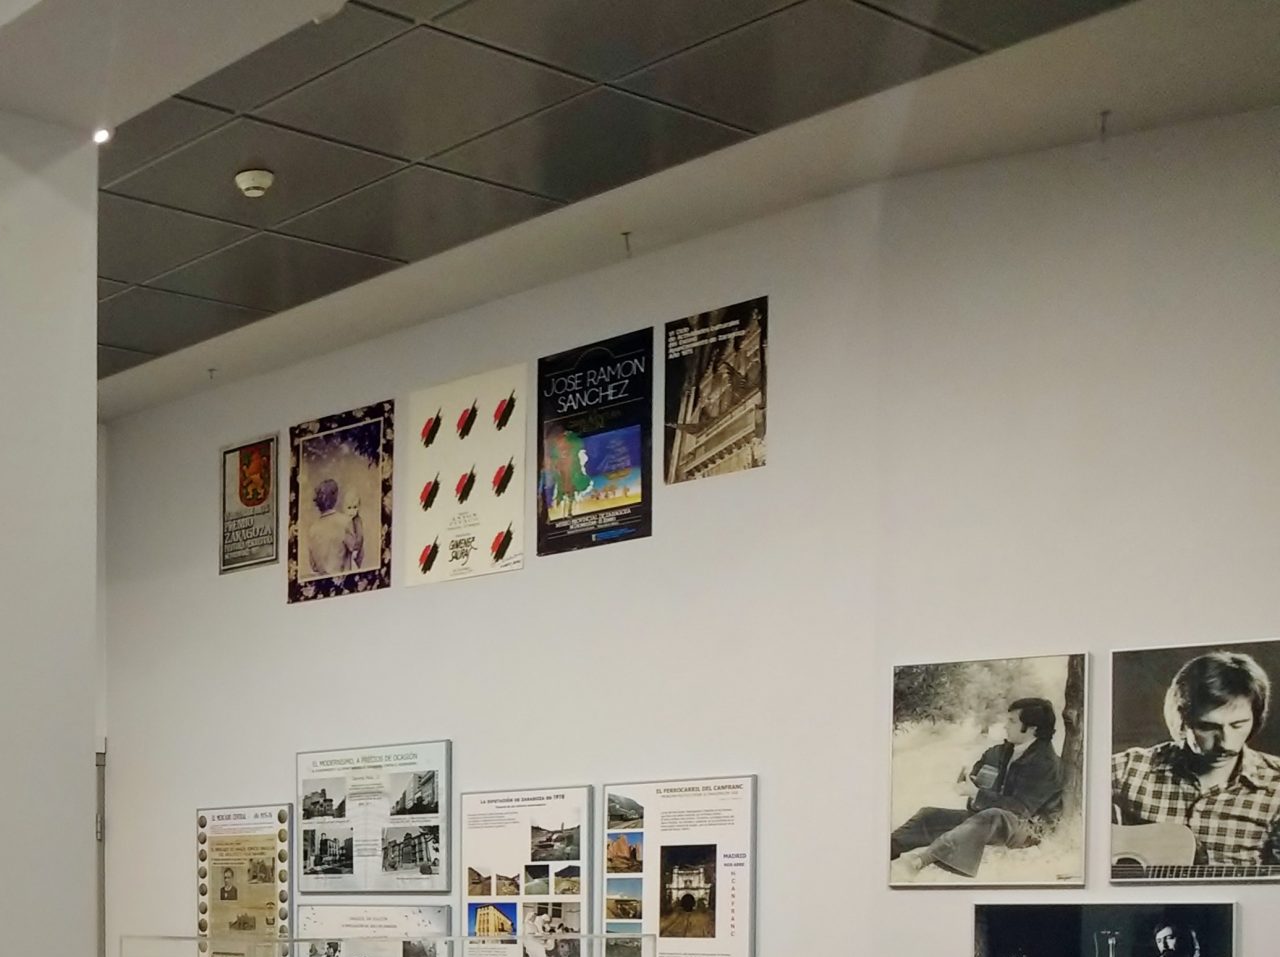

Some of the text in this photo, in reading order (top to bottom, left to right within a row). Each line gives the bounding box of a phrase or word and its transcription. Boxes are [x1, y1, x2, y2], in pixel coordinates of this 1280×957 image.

[543, 356, 645, 397] JOSE RAMON
[556, 379, 629, 413] SANCHEZ
[224, 527, 272, 544] ZARAGOZA
[663, 786, 700, 794] FERROCARRIL
[713, 783, 744, 791] CANFRANC
